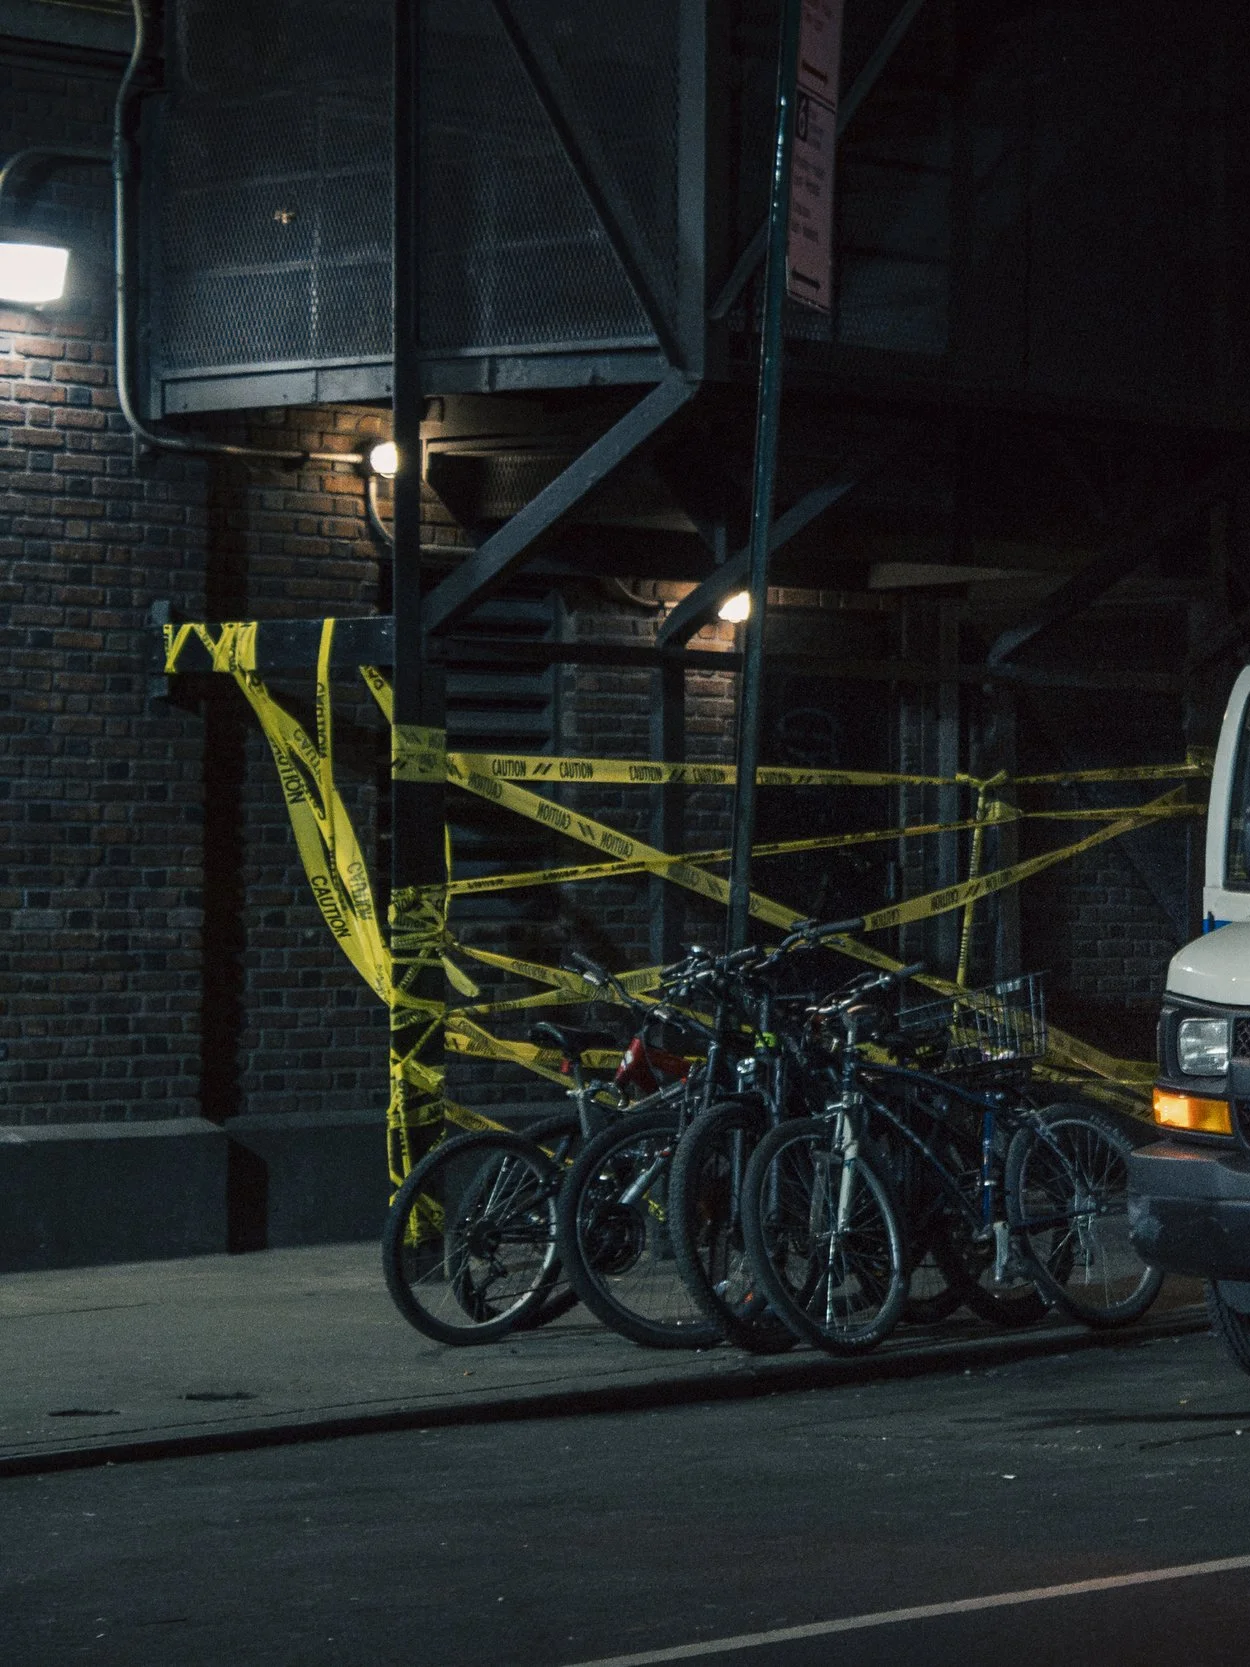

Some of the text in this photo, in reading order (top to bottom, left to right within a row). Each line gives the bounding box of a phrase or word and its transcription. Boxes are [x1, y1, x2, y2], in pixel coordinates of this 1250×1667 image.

[491, 759, 527, 777] CAUTION
[559, 761, 594, 779] CAUTION
[628, 765, 662, 782] CAUTION
[310, 875, 352, 938] CAUTION
